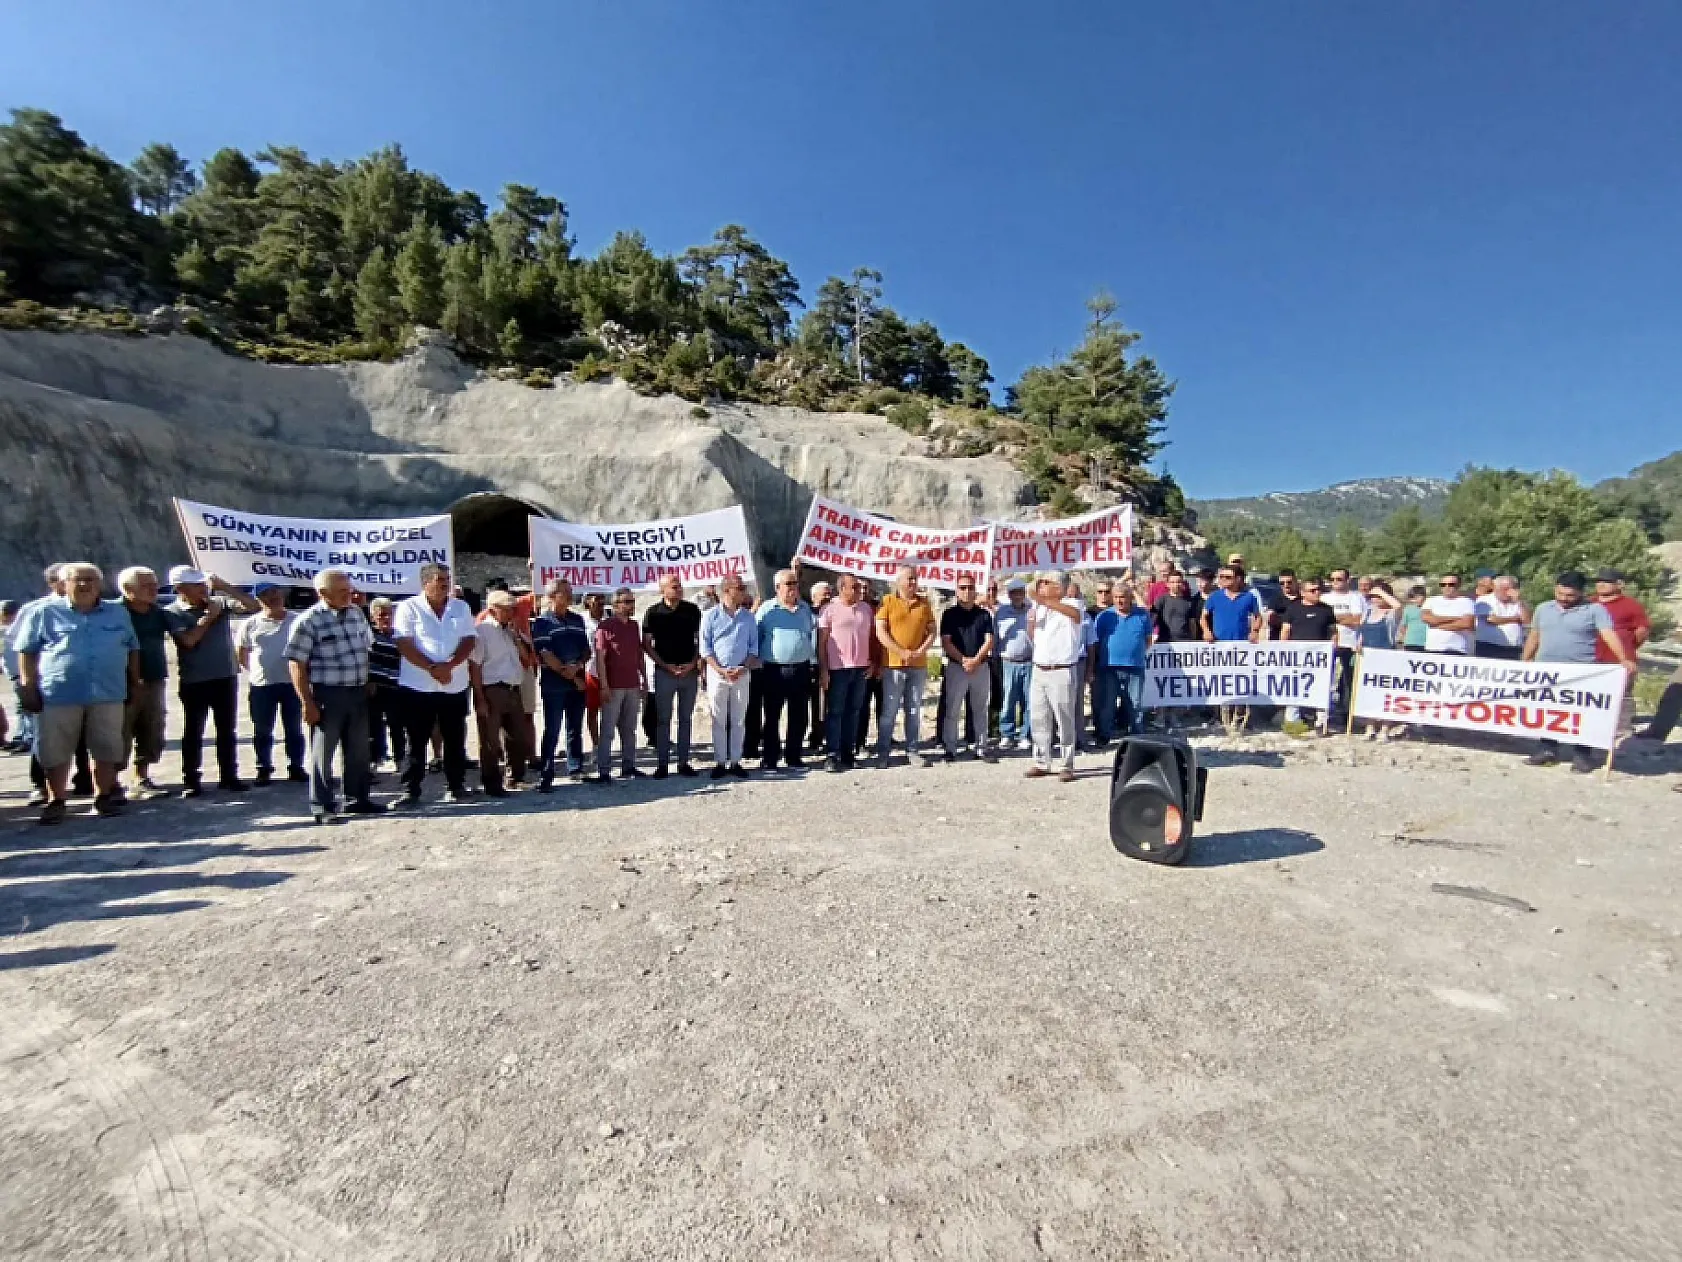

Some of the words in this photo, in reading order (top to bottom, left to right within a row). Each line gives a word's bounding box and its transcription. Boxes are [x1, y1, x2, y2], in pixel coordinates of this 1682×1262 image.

[202, 512, 327, 543] DÜNYANIN
[332, 531, 361, 544] EN
[366, 525, 432, 543] GÜZEL
[596, 524, 686, 545] VERGİYİ
[816, 504, 884, 539] TRAFİK
[194, 536, 323, 565] BELDESİNE,
[329, 551, 357, 565] BU
[363, 549, 446, 565] YOLDAN
[559, 544, 595, 561] BİZ
[601, 537, 726, 562] VERİYORUZ
[808, 524, 872, 556] ARTIK
[878, 545, 907, 560] BU
[917, 547, 986, 564] YOLDA
[992, 542, 1038, 570] RTIK
[1047, 536, 1131, 563] YETER!
[540, 566, 613, 586] HİZMET
[621, 555, 747, 585] ALAMIYORUZ!
[873, 562, 984, 586] TUMASIN!
[1144, 647, 1249, 669] YİTİRDİĞİMİZ
[1254, 650, 1328, 668] CANLAR
[1408, 659, 1559, 685] YOLUMUZUN
[1154, 670, 1258, 697] YETMEDİ
[1267, 670, 1315, 697] Mİ?
[1363, 673, 1442, 695] HEMEN
[1448, 683, 1611, 710] YAPILMASINI
[1383, 694, 1582, 735] İSTİYORUZ!
